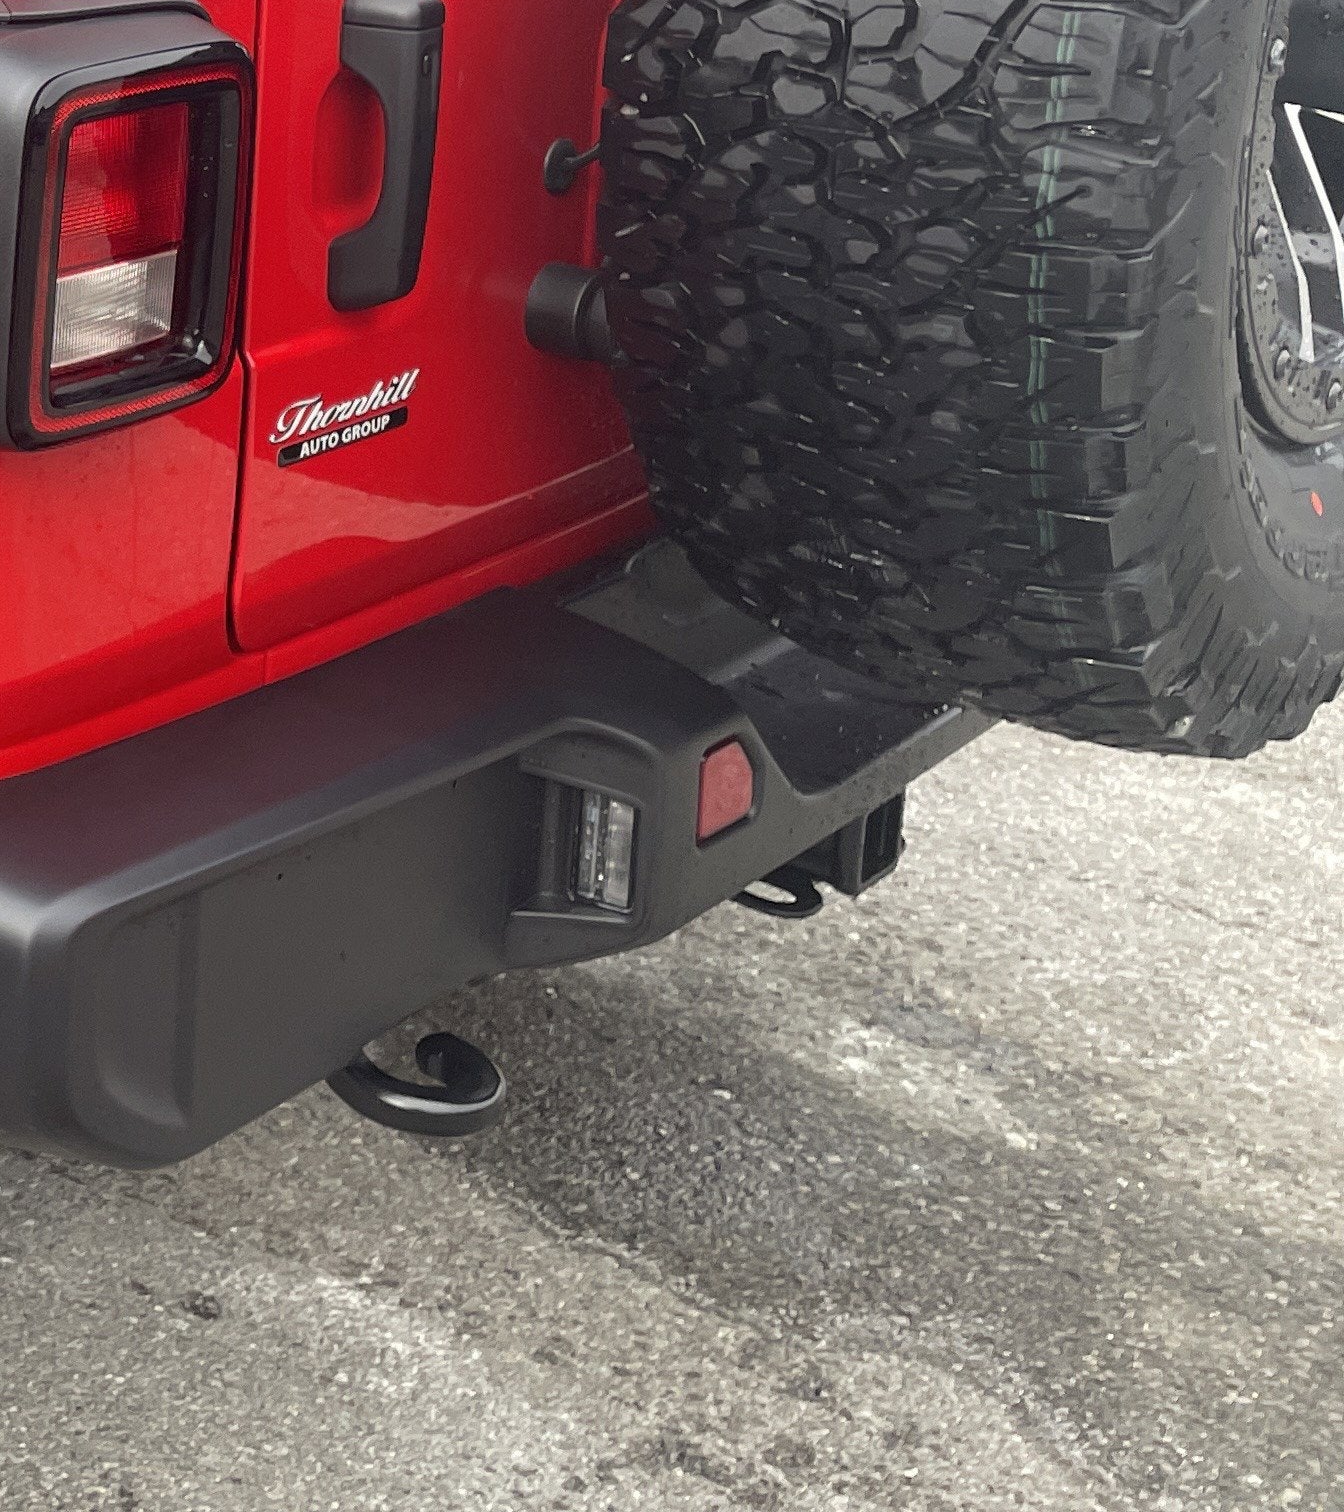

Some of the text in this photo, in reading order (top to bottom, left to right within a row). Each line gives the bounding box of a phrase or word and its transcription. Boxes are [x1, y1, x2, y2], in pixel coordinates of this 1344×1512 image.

[268, 368, 421, 444] Thornhill
[299, 414, 391, 459] AUTO GROUP
